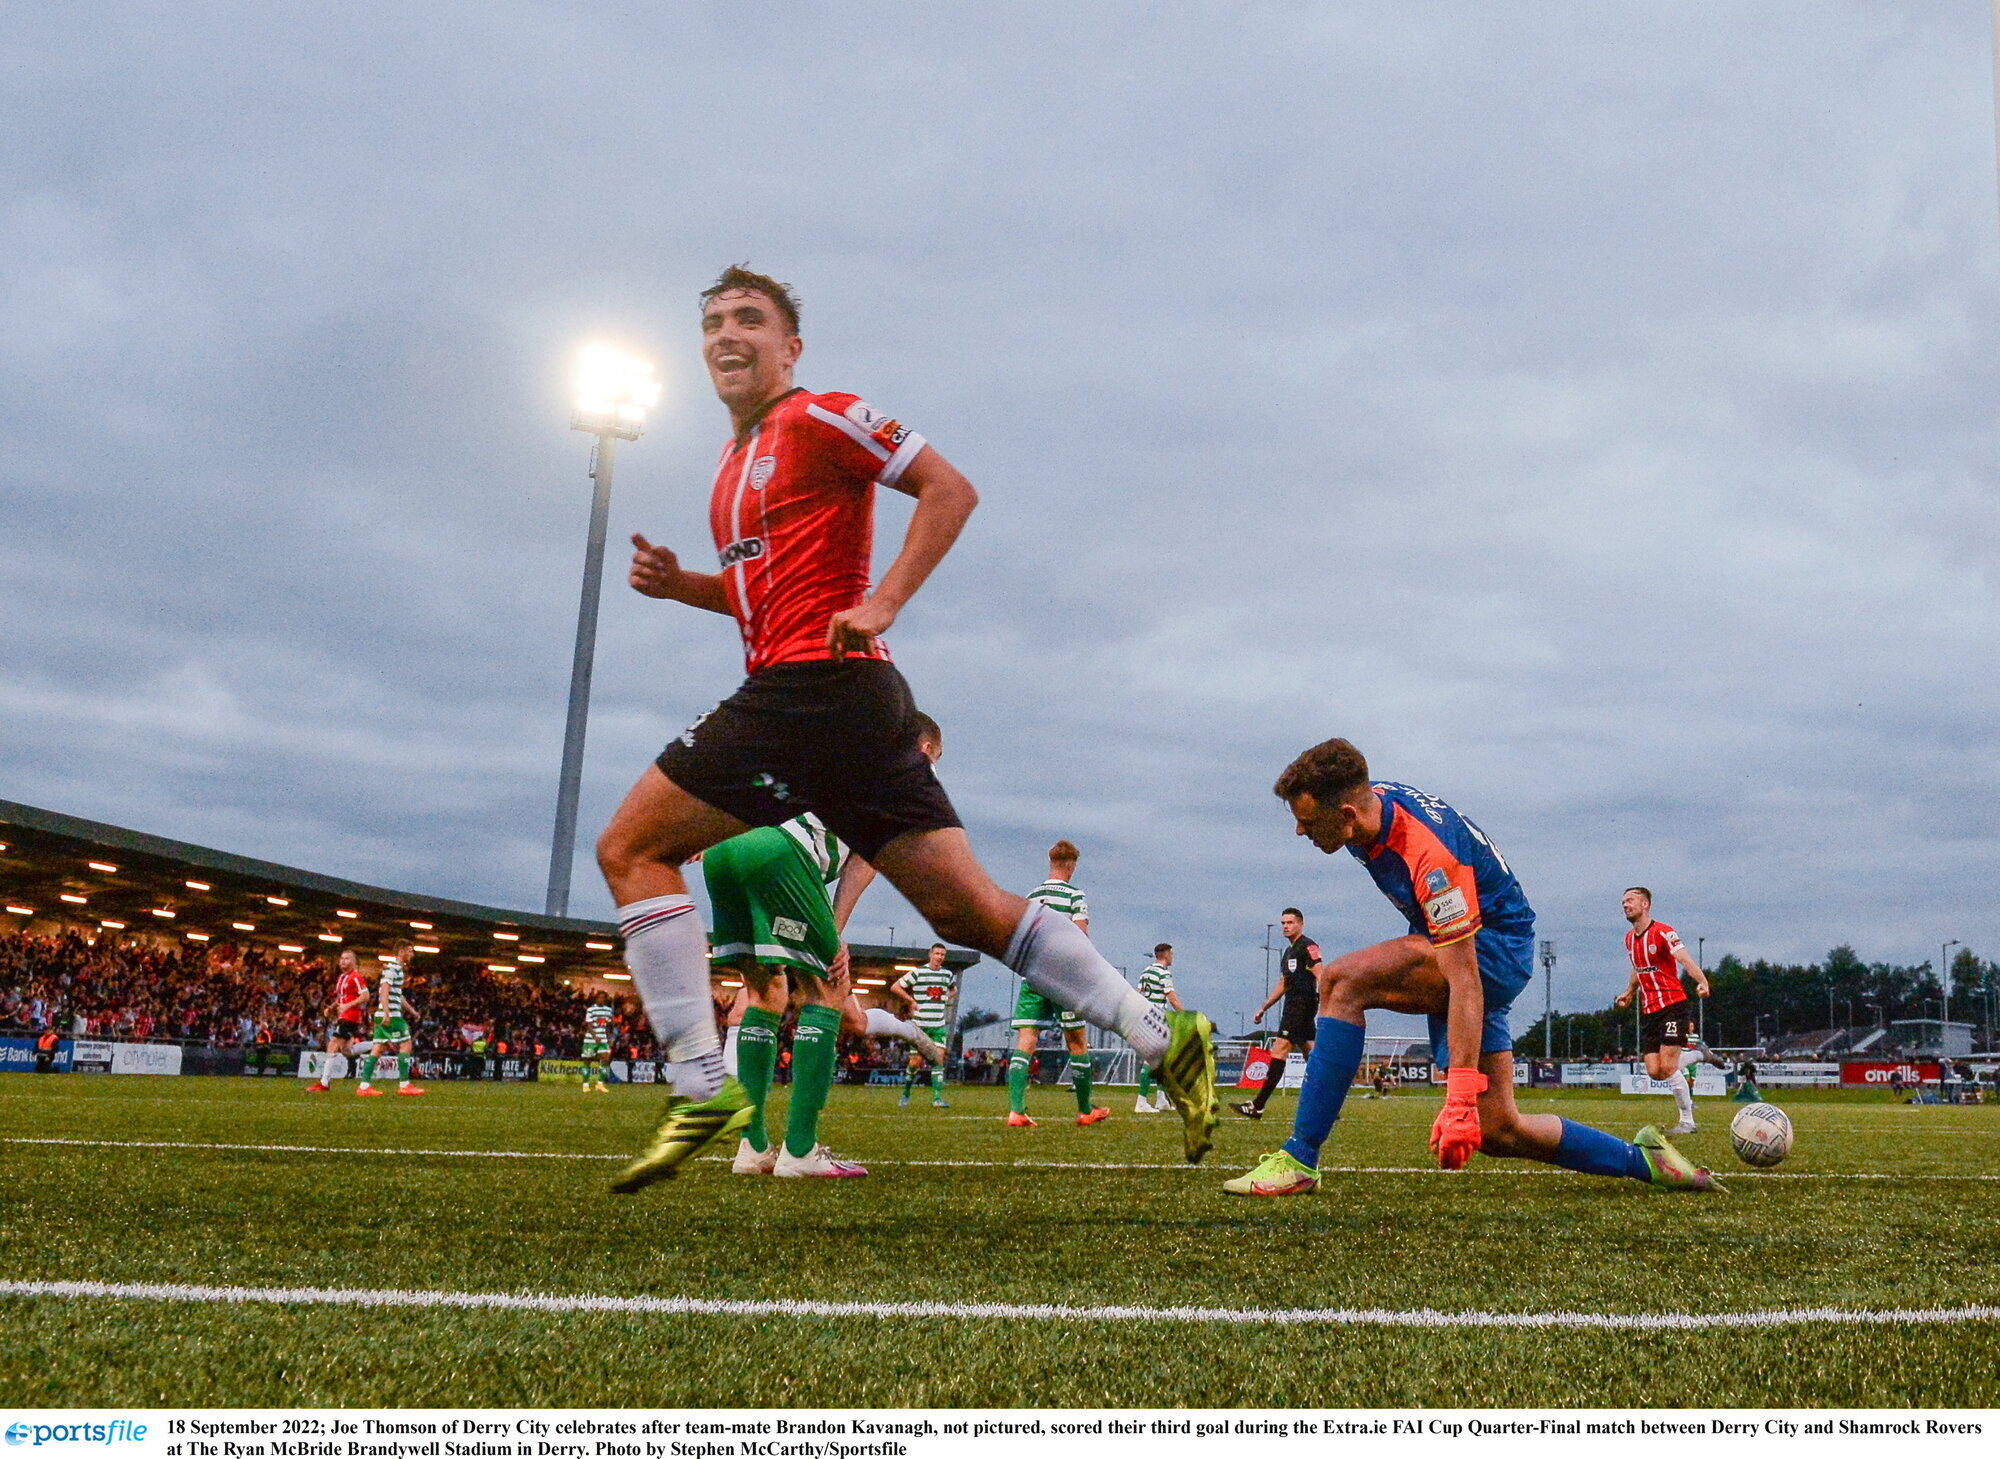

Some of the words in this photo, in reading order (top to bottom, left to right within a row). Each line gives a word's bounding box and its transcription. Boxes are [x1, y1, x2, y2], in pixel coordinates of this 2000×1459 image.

[1665, 1021, 1677, 1033] 23
[741, 1035, 774, 1044] umbro
[794, 1034, 819, 1043] mbro
